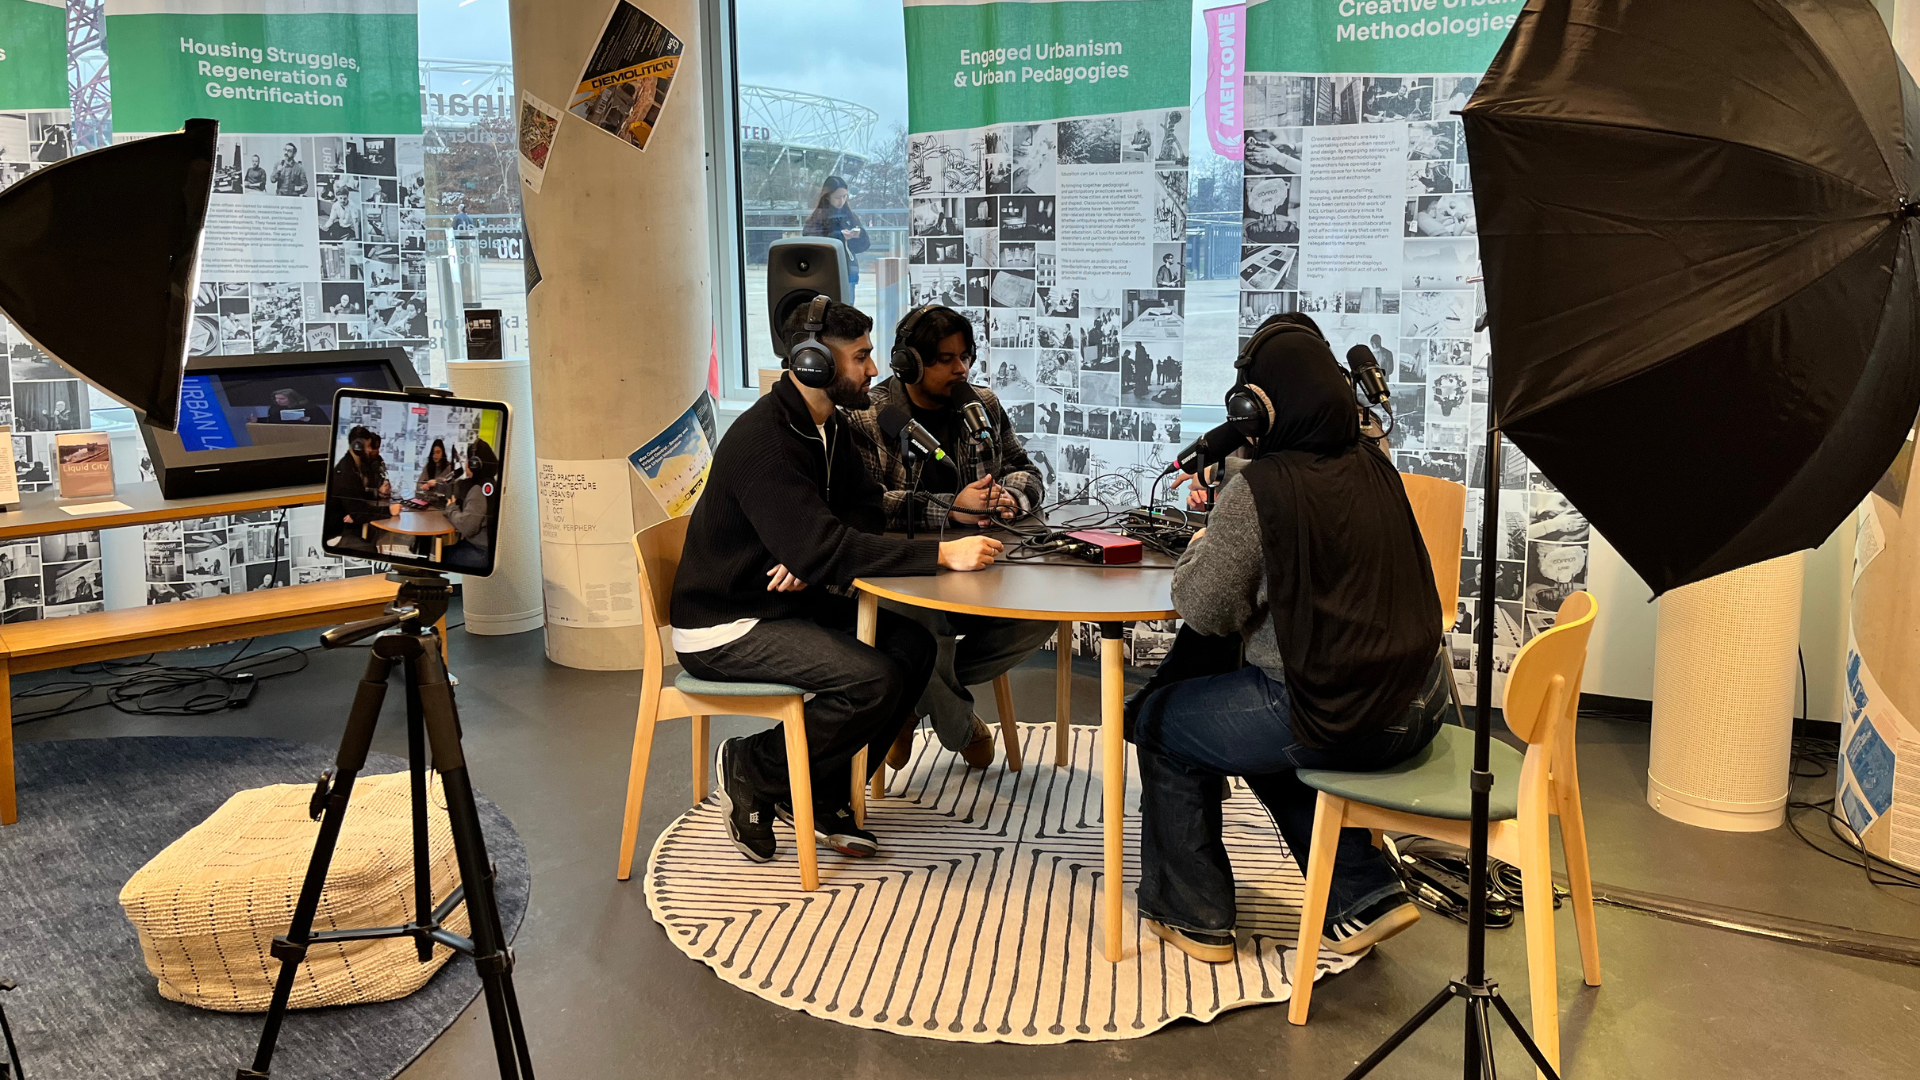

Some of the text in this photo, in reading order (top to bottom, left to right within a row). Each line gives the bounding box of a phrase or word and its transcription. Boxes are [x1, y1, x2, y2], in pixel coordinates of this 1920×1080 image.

[1339, 0, 1436, 17] Creative
[1337, 12, 1518, 42] Methodologies
[180, 37, 360, 72] Housing Struggles,
[961, 39, 1122, 68] Engaged Urbanism
[199, 60, 347, 87] Regeneration &
[591, 60, 674, 89] DEMOLITION
[954, 62, 1129, 88] & Urban Pedagogies
[206, 82, 344, 106] Gentrification
[742, 126, 770, 140] TED
[182, 379, 218, 430] URBAN
[63, 463, 109, 473] Liquid City
[642, 456, 654, 467] Virtual
[654, 446, 668, 458] Control
